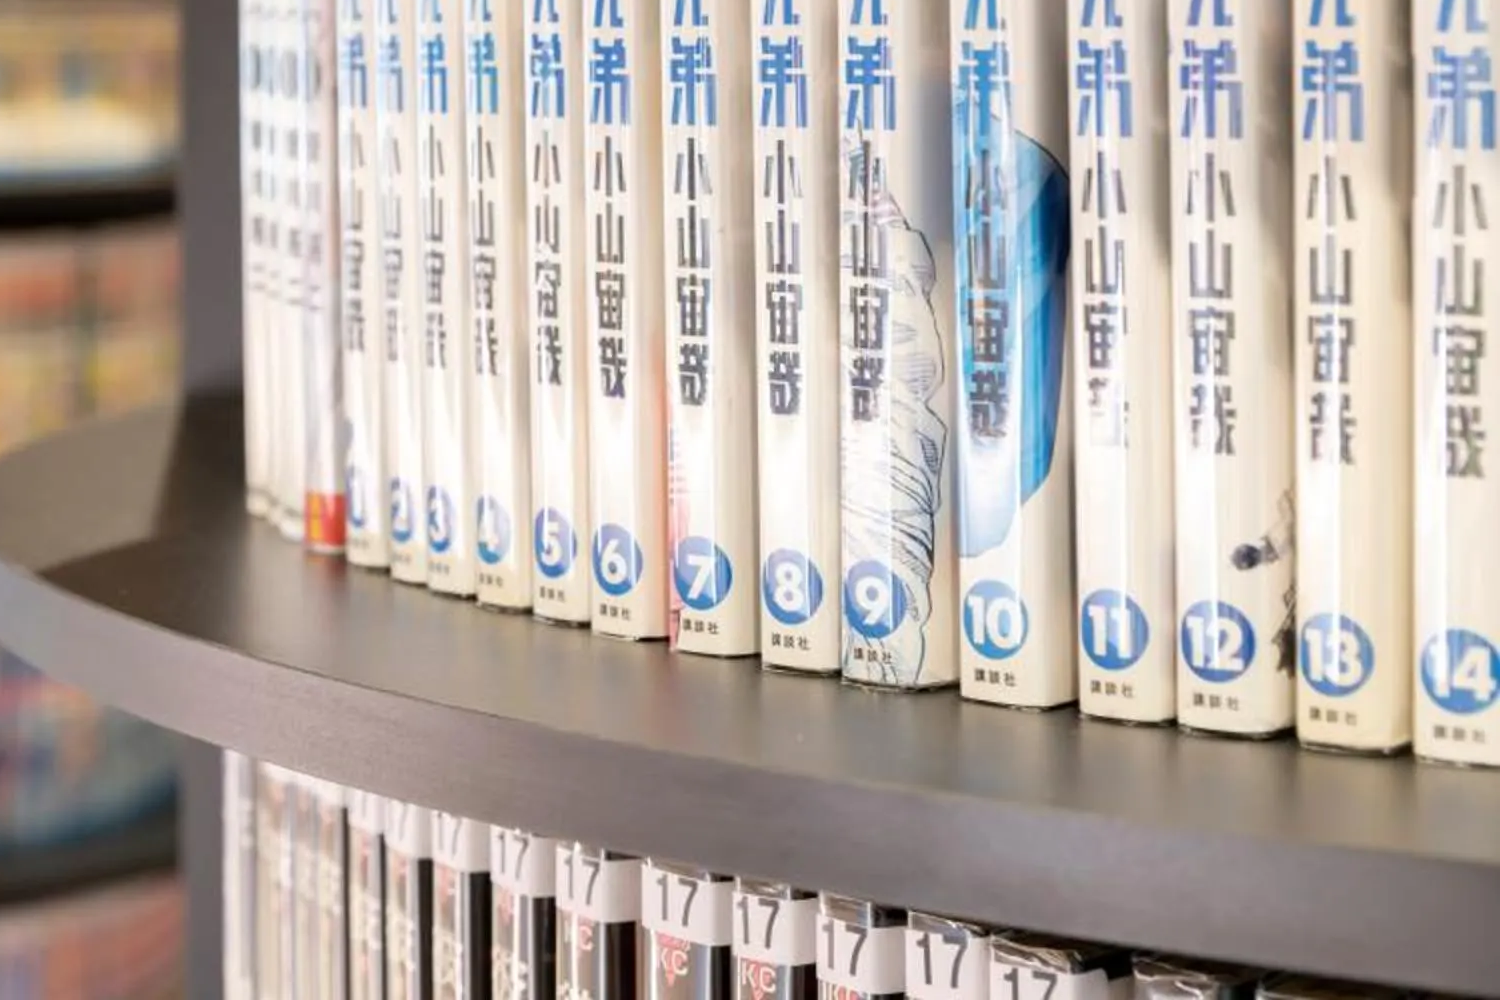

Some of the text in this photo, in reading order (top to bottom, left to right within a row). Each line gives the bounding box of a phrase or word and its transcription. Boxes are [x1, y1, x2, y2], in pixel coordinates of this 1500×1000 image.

[541, 521, 563, 570] 5
[601, 539, 627, 585] 6
[686, 554, 714, 600] 7
[773, 561, 804, 611] 8
[855, 576, 890, 626] 9
[967, 595, 1024, 649] 10
[1088, 604, 1136, 660] 11
[1186, 616, 1246, 672] 12
[1305, 628, 1365, 687] 13
[1429, 640, 1497, 702] 14
[497, 831, 530, 880] 17
[563, 854, 601, 906] 17
[656, 873, 699, 927] 17
[737, 895, 780, 950] 17
[822, 919, 867, 976] 17
[916, 932, 968, 989] 17
[741, 959, 777, 994] KC
